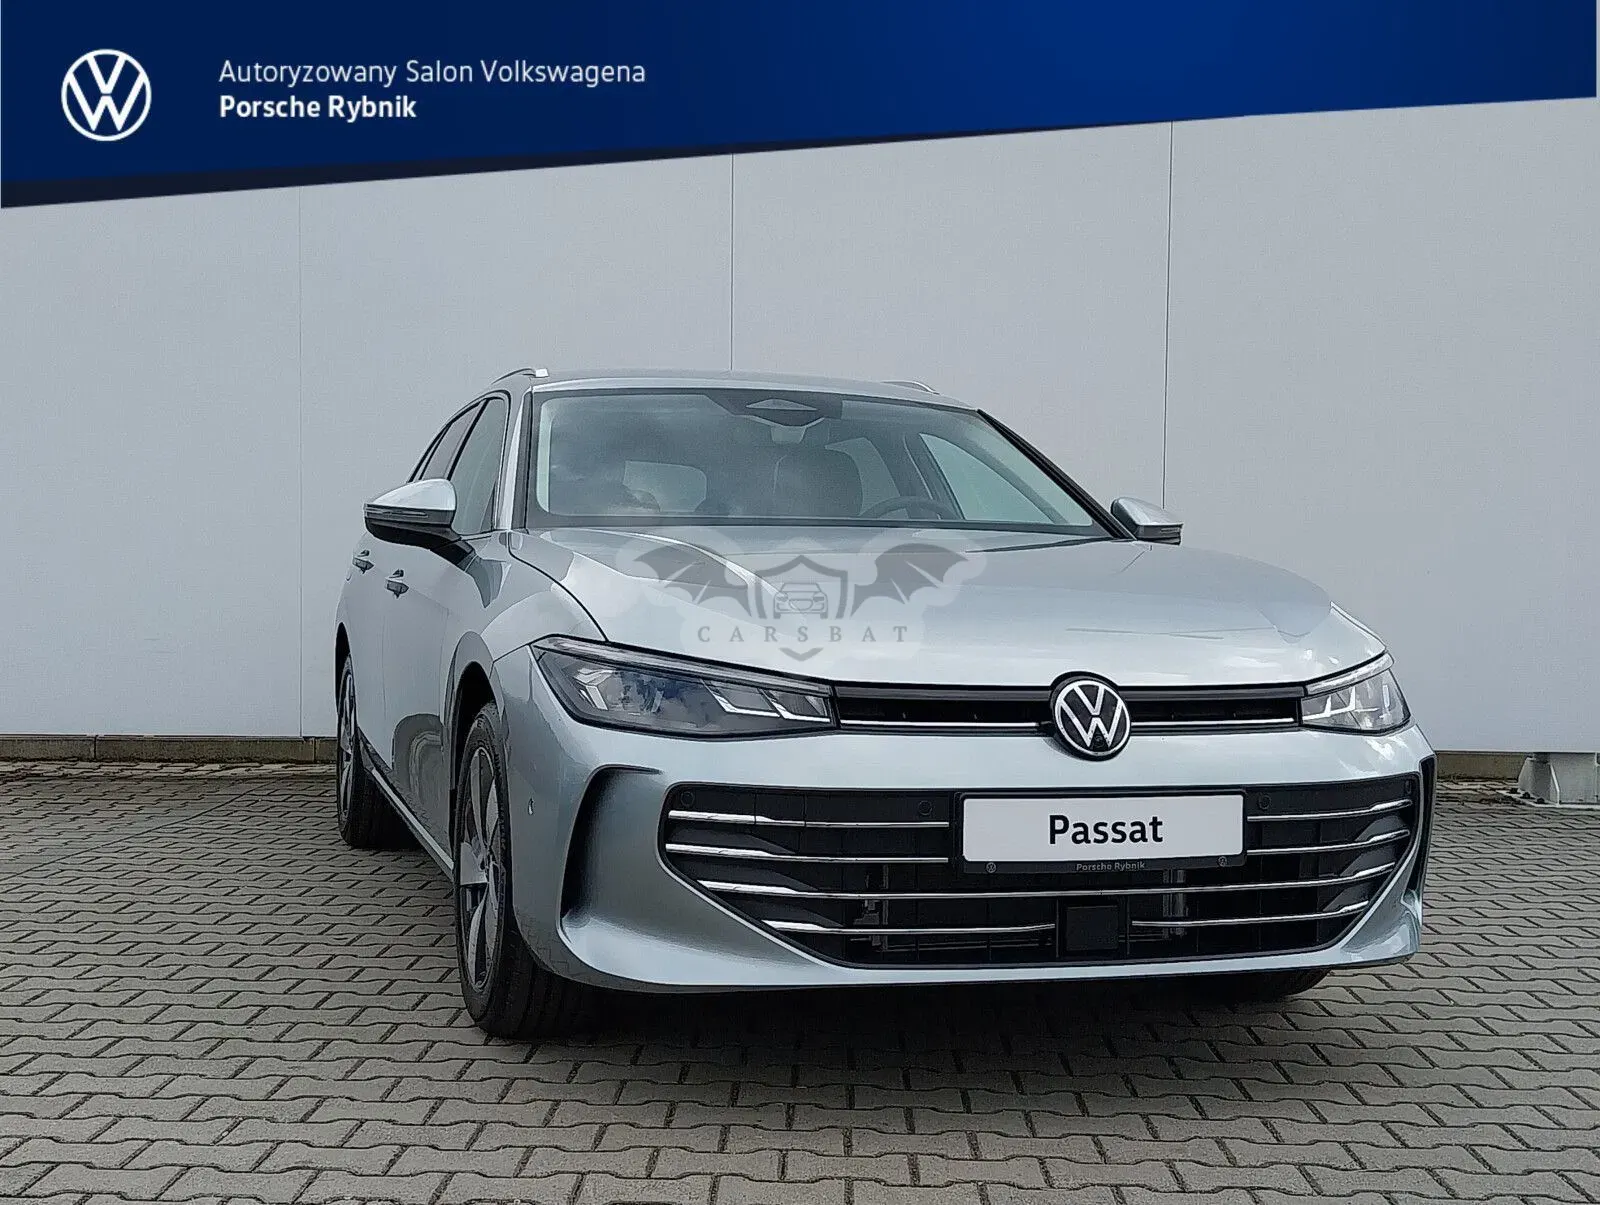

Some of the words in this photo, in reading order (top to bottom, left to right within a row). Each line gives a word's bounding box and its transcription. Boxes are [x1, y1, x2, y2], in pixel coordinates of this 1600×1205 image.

[1049, 814, 1164, 845] Passat
[1076, 863, 1112, 871] Porsche
[1114, 861, 1146, 871] Rybnik
